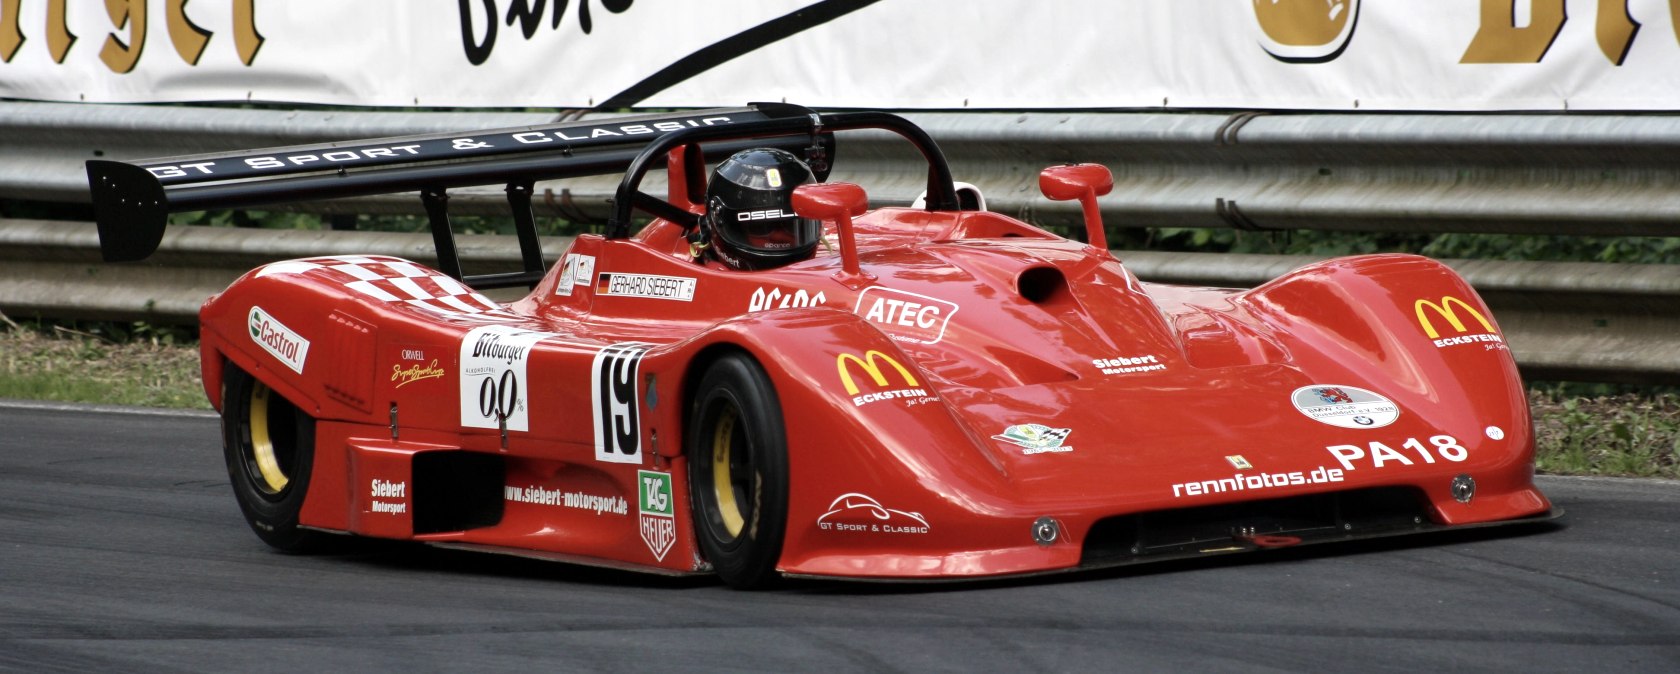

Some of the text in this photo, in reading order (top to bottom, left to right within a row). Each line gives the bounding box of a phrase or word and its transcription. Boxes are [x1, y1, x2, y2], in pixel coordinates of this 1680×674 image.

[146, 162, 216, 179] GT
[244, 144, 421, 169] SPORT
[452, 138, 495, 150] &
[737, 208, 799, 222] OSEL
[611, 275, 646, 295] GERHARD
[647, 277, 685, 297] SIEBERT
[865, 297, 940, 329] ATEC
[260, 320, 299, 363] Castrol
[472, 332, 526, 365] Bitburger
[1433, 334, 1502, 348] ECKSTEIN
[401, 349, 424, 360] ORWELL
[1092, 354, 1159, 369] Siebert
[1102, 363, 1168, 375] Motorsport
[600, 343, 648, 455] 19
[852, 388, 928, 407] ECKSTEIN
[1325, 434, 1469, 471] PA18
[371, 478, 406, 498] Siebert
[1172, 465, 1345, 498] rennfotos.de
[643, 477, 668, 512] TAG
[372, 500, 407, 515] Motorsport
[642, 516, 674, 554] HEUER
[819, 522, 928, 534] GT SPORT & CLASSIC
